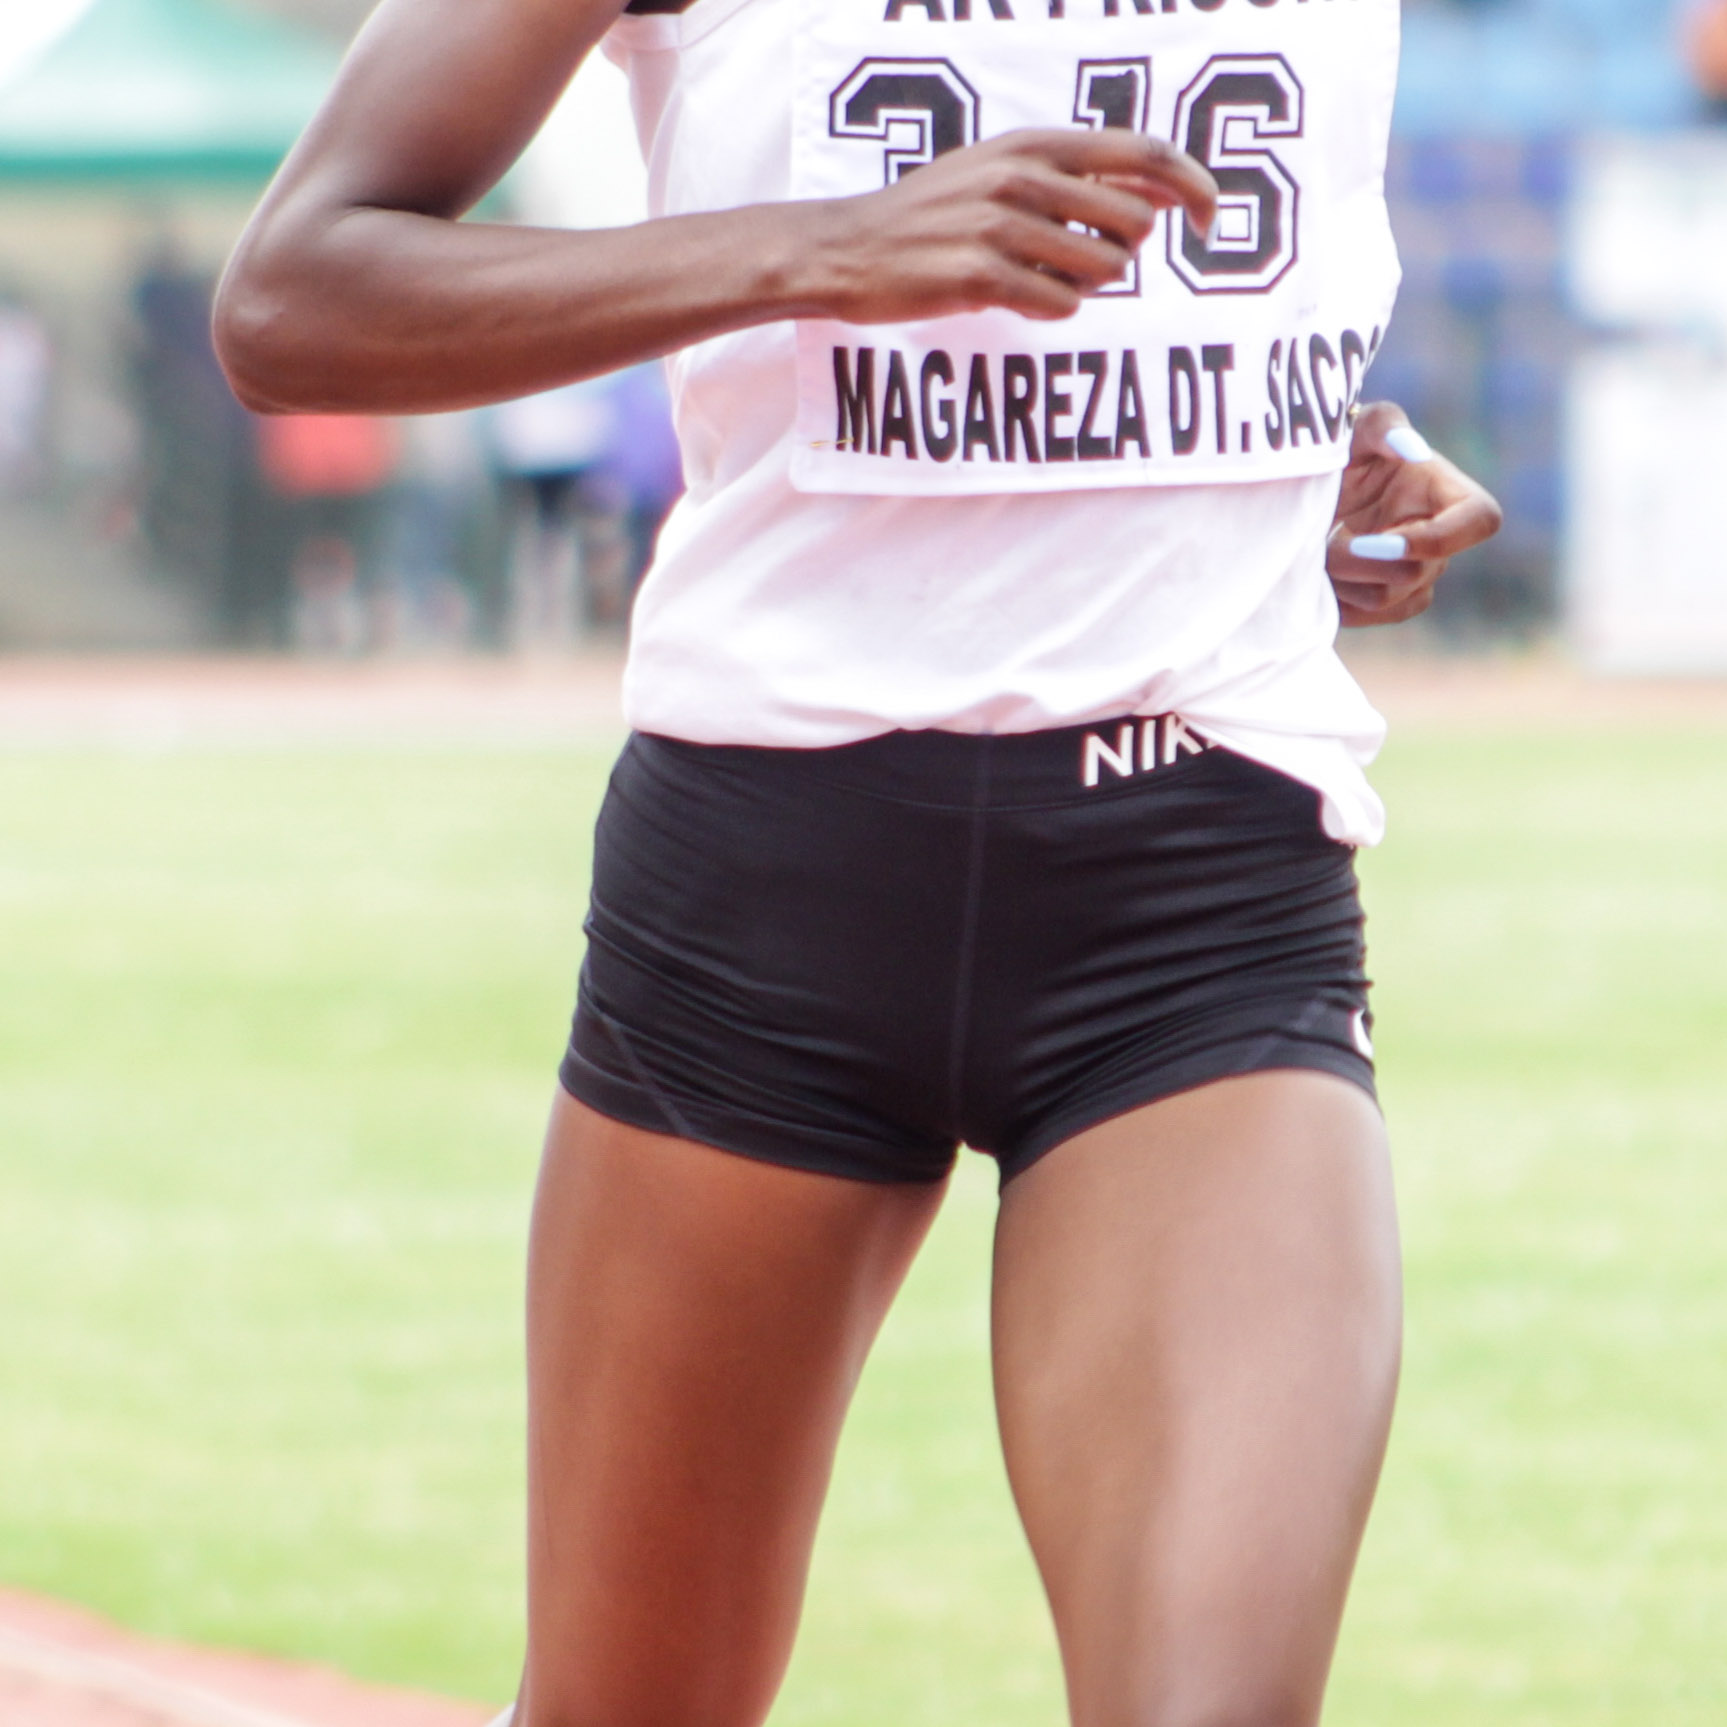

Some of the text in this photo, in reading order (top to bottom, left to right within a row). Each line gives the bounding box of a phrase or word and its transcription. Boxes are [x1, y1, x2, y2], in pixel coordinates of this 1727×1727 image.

[832, 324, 1379, 464] MAGAREZA DT. SACC
[1083, 713, 1220, 788] NIK
